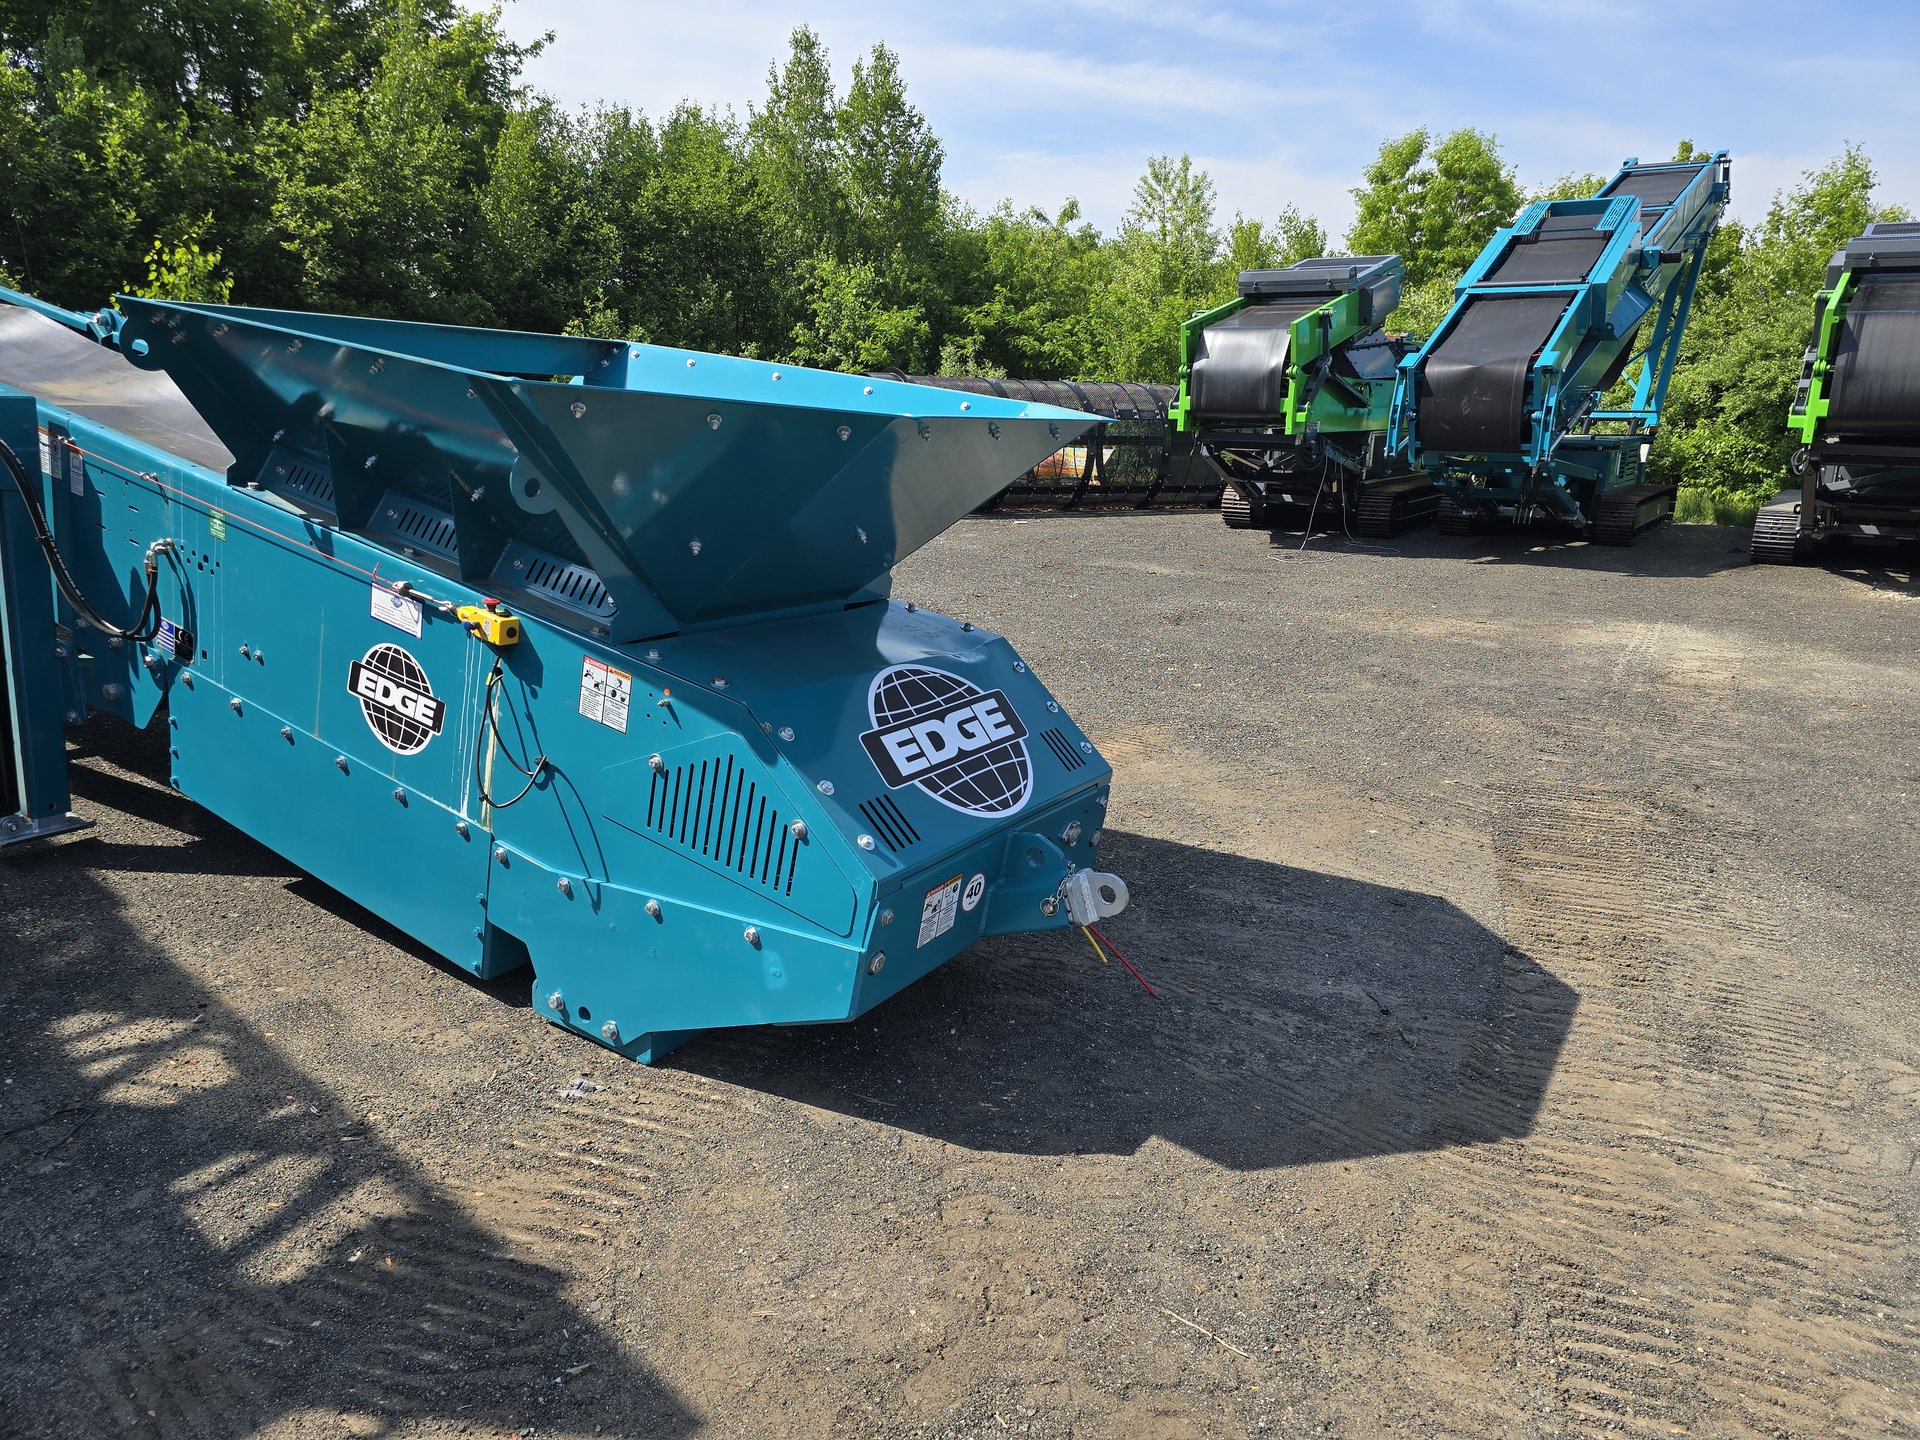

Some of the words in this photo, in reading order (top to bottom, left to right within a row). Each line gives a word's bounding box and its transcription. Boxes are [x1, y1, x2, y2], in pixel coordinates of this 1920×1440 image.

[357, 667, 437, 727] EDGE
[880, 698, 1016, 777] EDGE
[966, 882, 982, 900] 40
